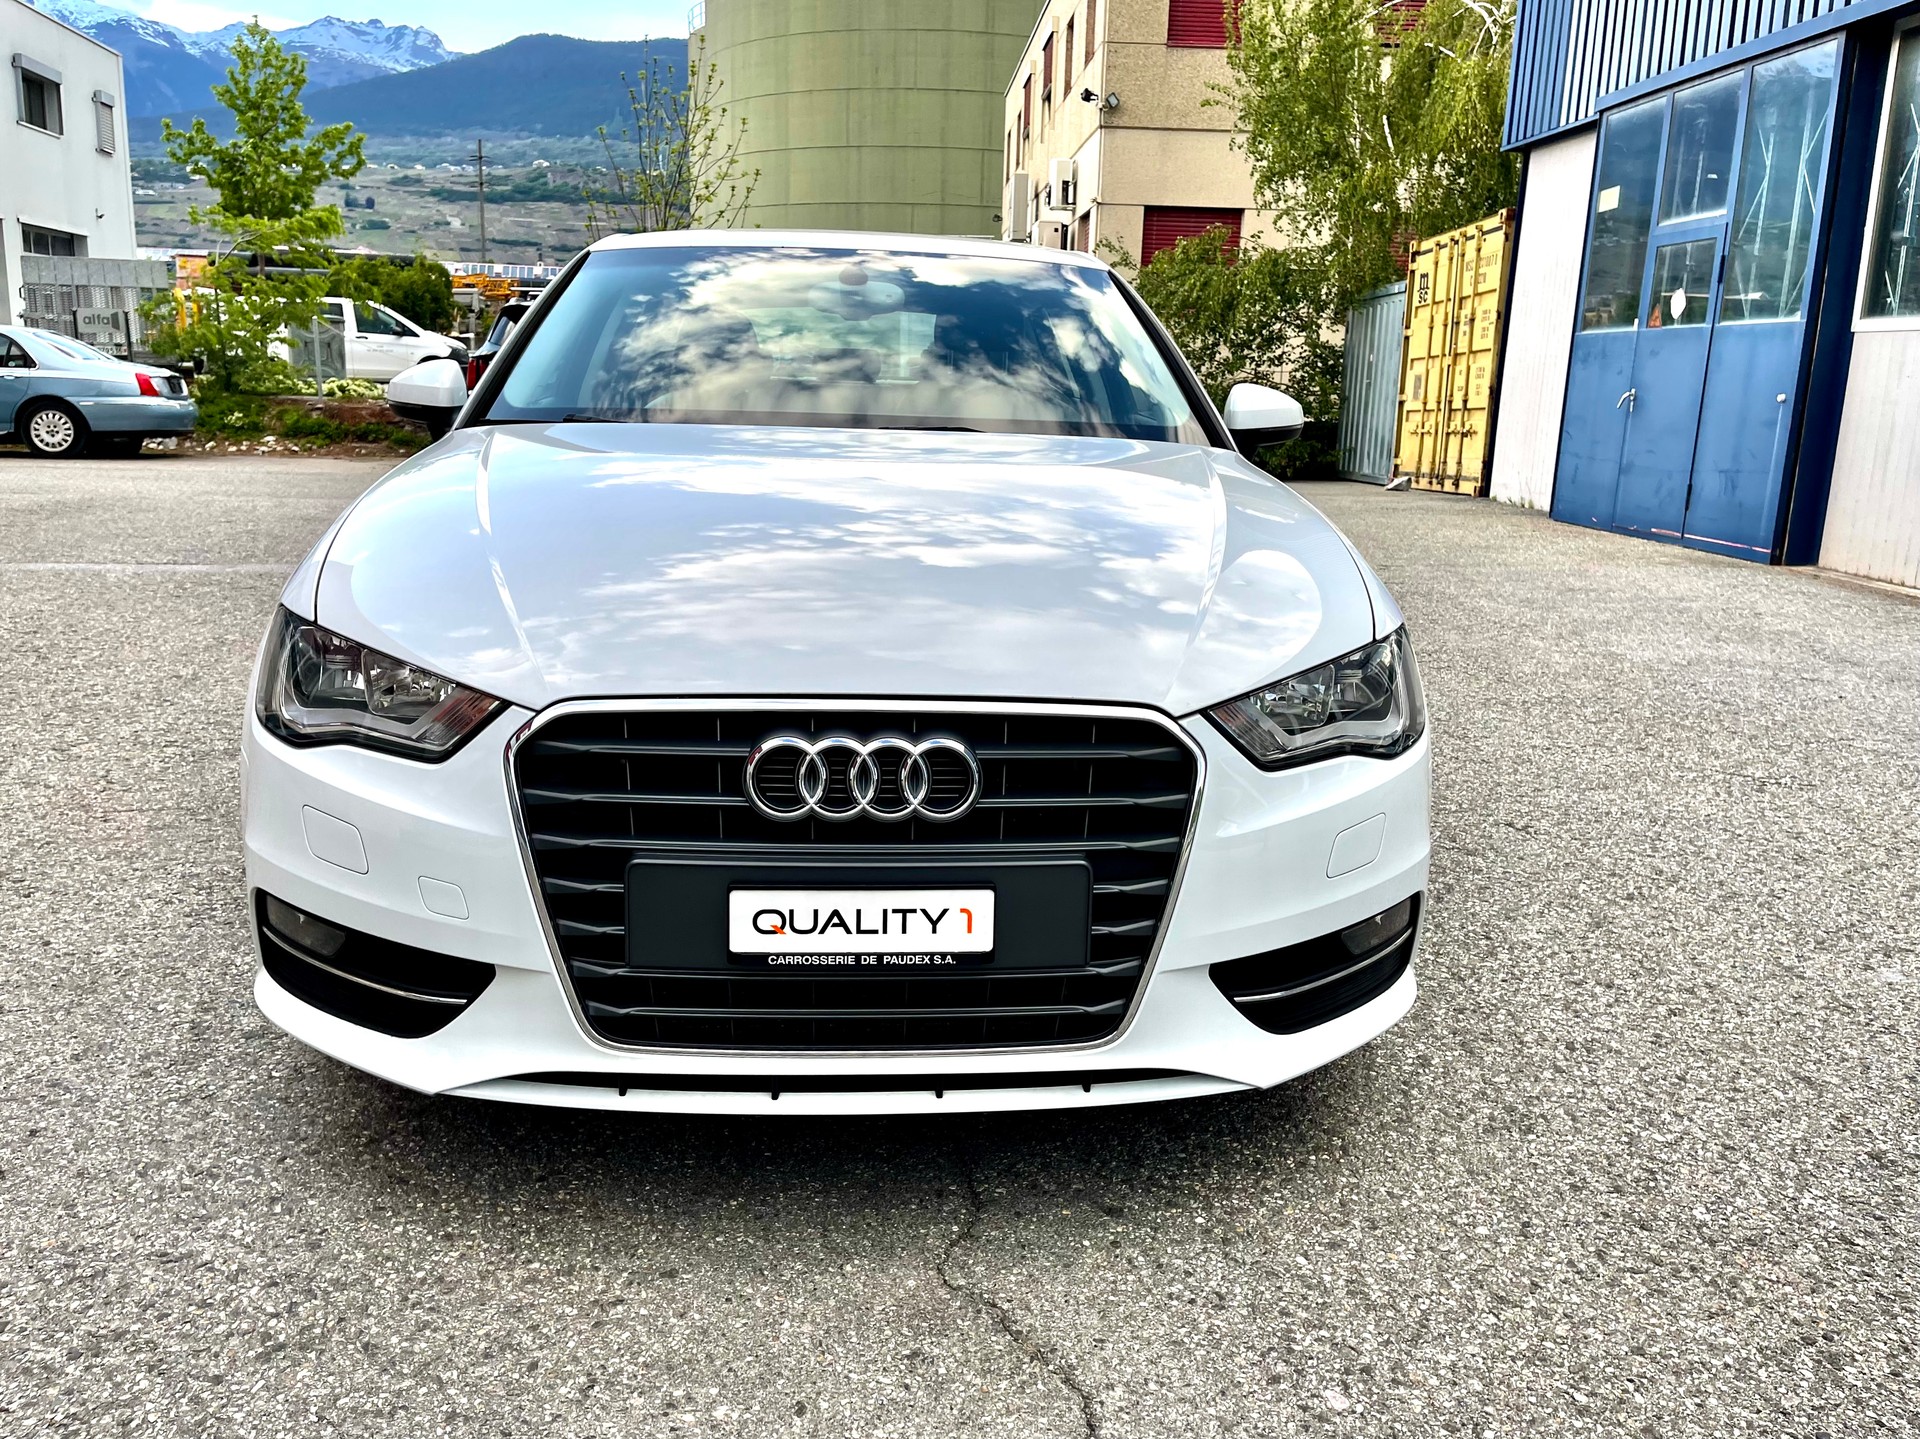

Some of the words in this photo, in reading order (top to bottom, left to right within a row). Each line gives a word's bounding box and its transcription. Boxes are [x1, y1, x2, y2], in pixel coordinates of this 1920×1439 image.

[83, 314, 110, 325] alfa
[752, 908, 949, 935] QUALITY
[960, 908, 973, 934] 1
[768, 955, 856, 965] CARROSSERIE
[860, 955, 878, 965] DE
[883, 955, 931, 965] PAUDEX
[933, 955, 957, 965] S.A.
